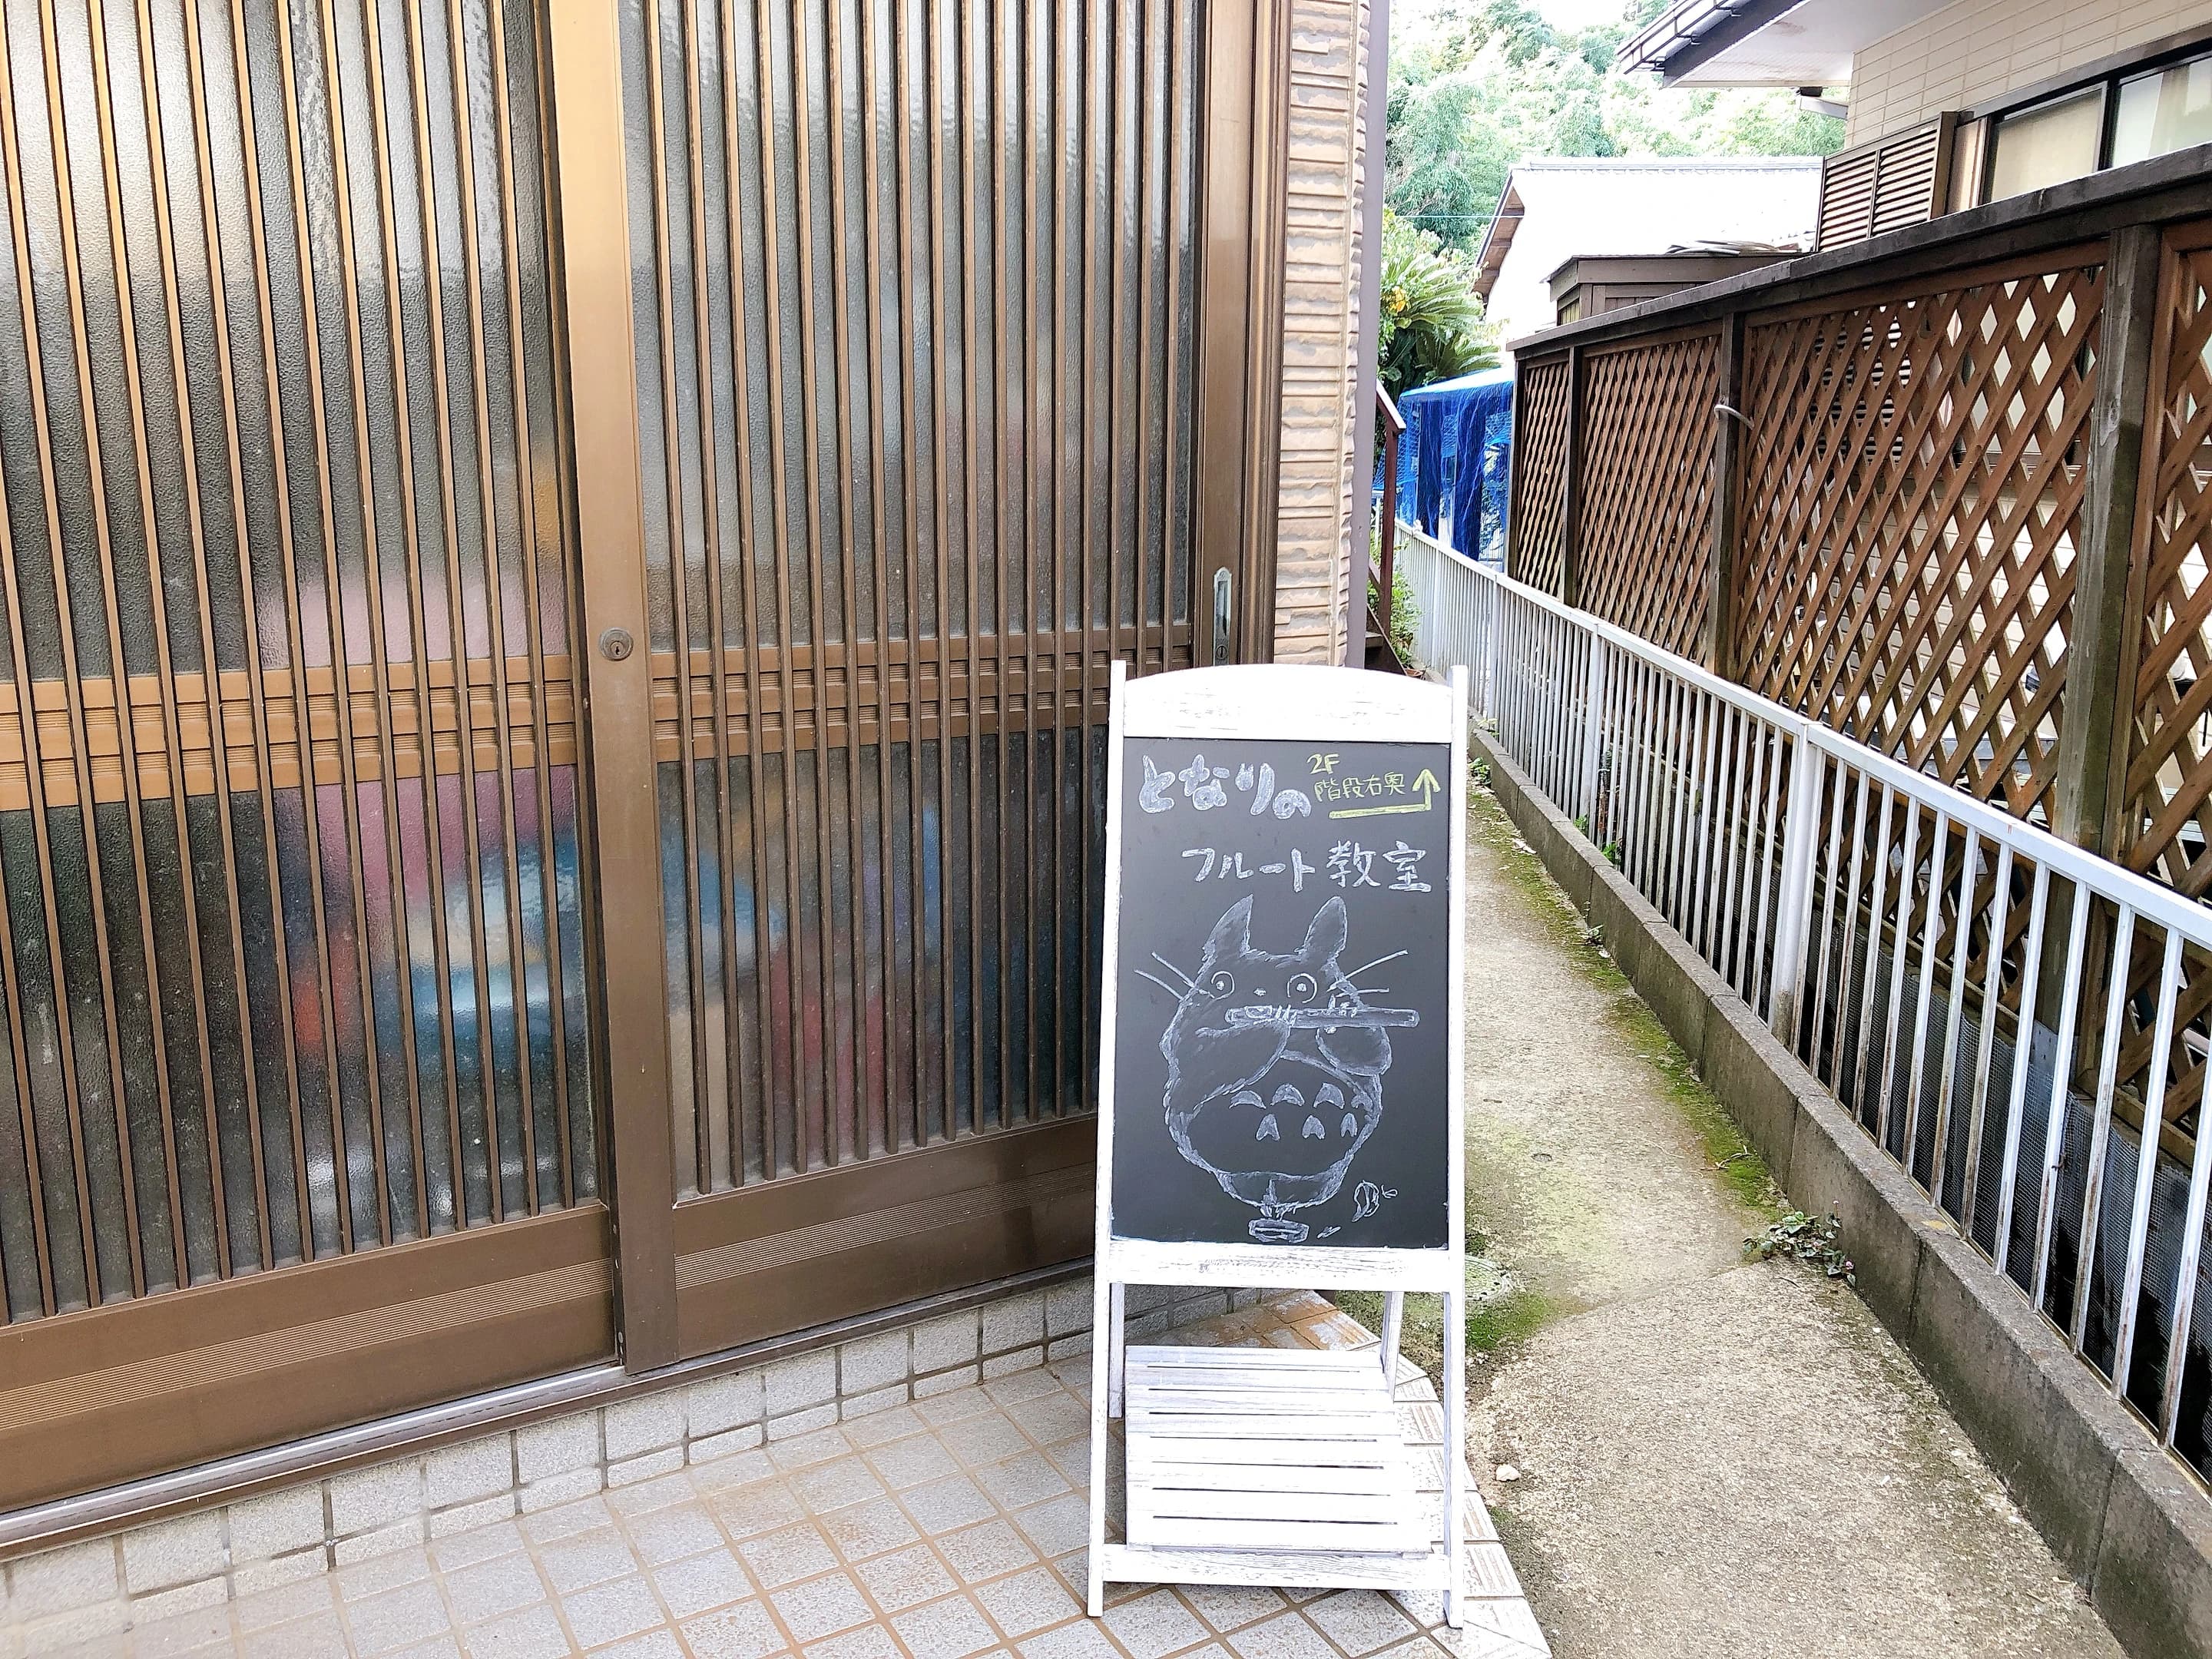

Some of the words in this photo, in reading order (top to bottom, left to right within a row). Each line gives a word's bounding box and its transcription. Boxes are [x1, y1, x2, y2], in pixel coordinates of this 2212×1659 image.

[1306, 753, 1339, 775] 2F
[1139, 753, 1312, 820] となりの
[1314, 771, 1406, 802] 階段右奥
